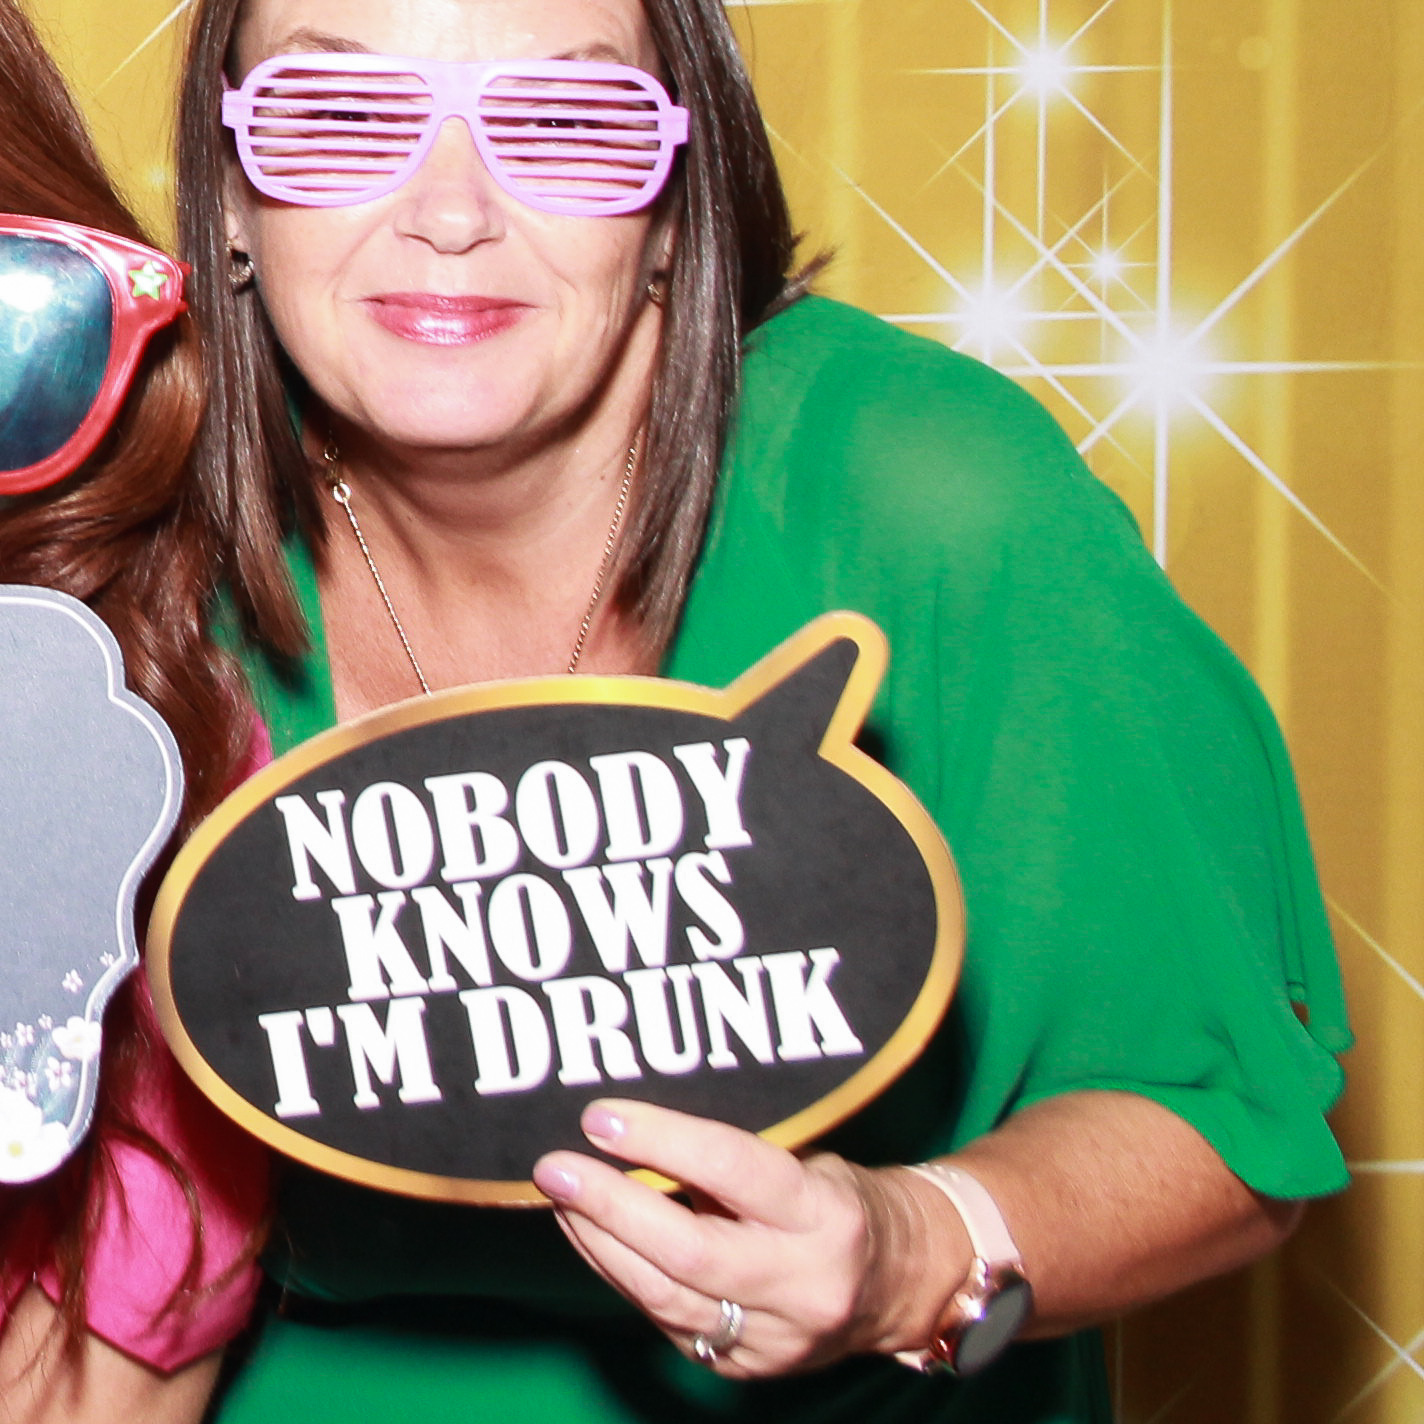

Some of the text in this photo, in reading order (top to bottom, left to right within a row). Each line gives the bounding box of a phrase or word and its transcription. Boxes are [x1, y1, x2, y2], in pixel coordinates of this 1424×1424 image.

[275, 738, 752, 900] NOBODY
[332, 851, 747, 1001] KNOWS
[258, 947, 863, 1118] I'M DRUNK
